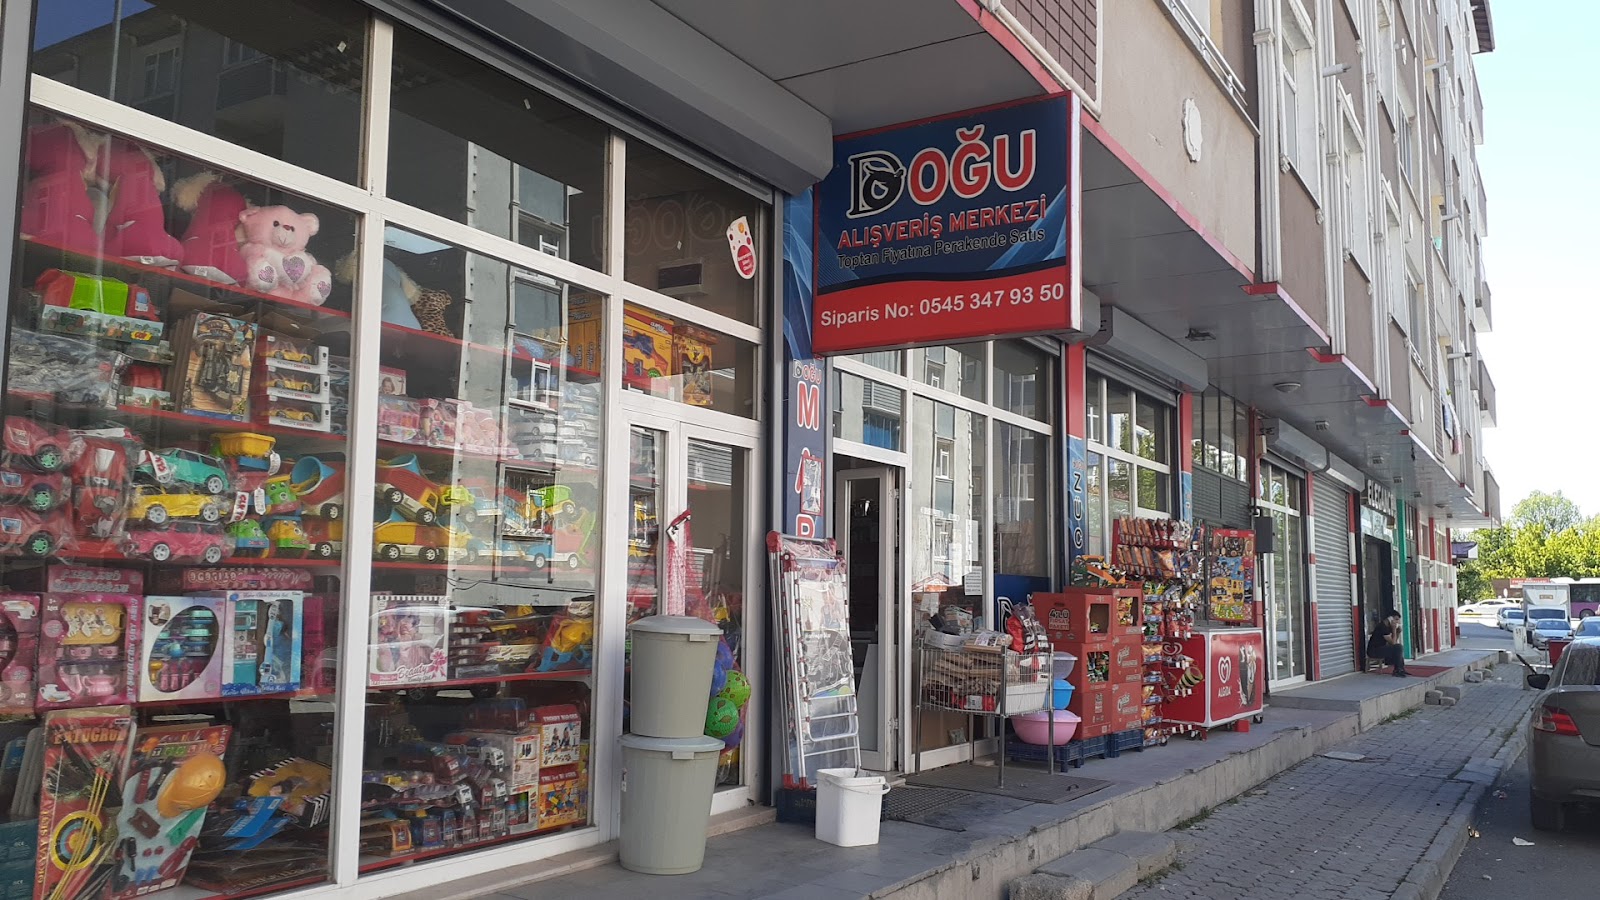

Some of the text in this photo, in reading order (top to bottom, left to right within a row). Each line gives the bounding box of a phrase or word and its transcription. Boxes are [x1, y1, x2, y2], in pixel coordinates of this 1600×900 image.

[846, 123, 1037, 220] DOĞU
[836, 193, 1048, 250] ALIŞVERİŞ MERKEZİ
[837, 249, 880, 271] Toptan
[881, 243, 932, 267] Fiyatına
[934, 234, 1007, 255] Perakende
[884, 302, 915, 318] No:
[919, 293, 964, 316] 0545
[969, 290, 1005, 310] 347
[1010, 286, 1034, 304] 93
[1040, 283, 1064, 302] 50
[792, 359, 823, 385] DOĞU
[396, 664, 429, 679] Beauty
